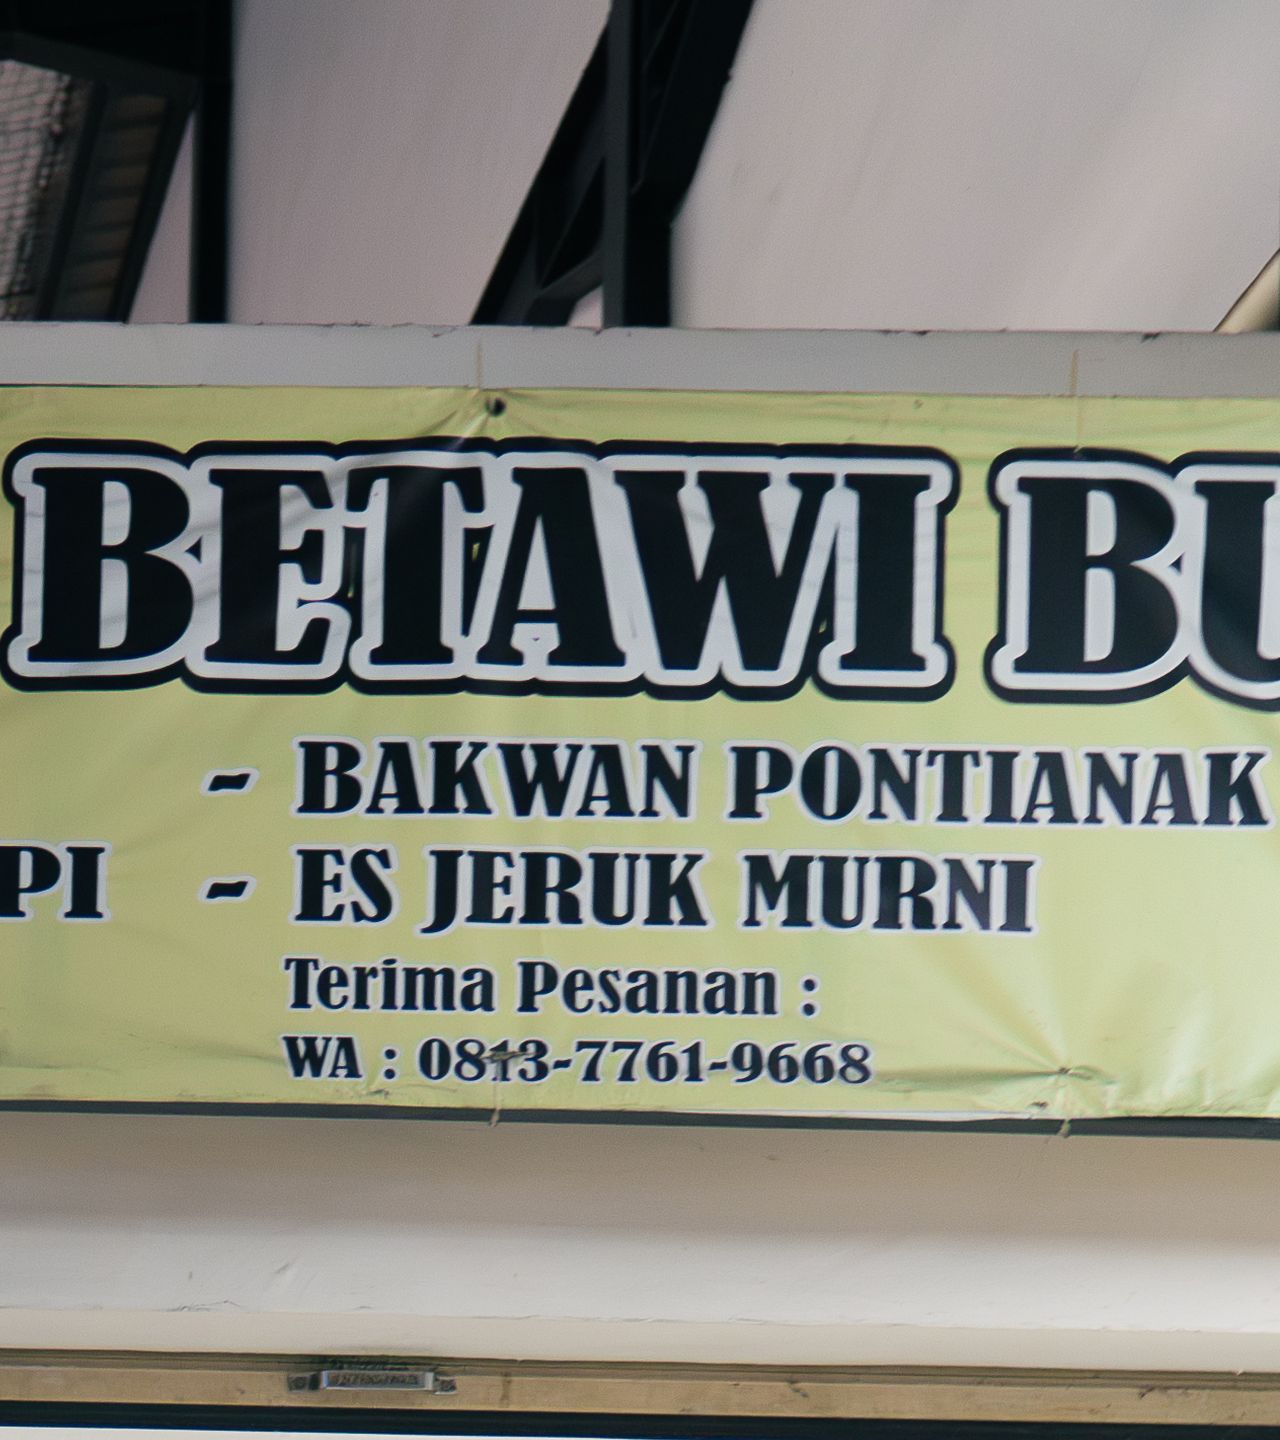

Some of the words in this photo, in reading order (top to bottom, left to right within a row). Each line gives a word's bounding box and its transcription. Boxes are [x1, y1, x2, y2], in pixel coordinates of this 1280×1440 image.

[297, 741, 695, 818] BAKWAN
[729, 746, 1267, 826] PONTIANAK
[295, 848, 392, 923] ES
[421, 850, 707, 934] JERUK
[743, 855, 1034, 932] MURNI
[284, 957, 495, 1013] Terima
[517, 960, 777, 1016] Pesanan
[282, 1035, 362, 1080] WA
[419, 1038, 871, 1084] 0813-7761-9668
